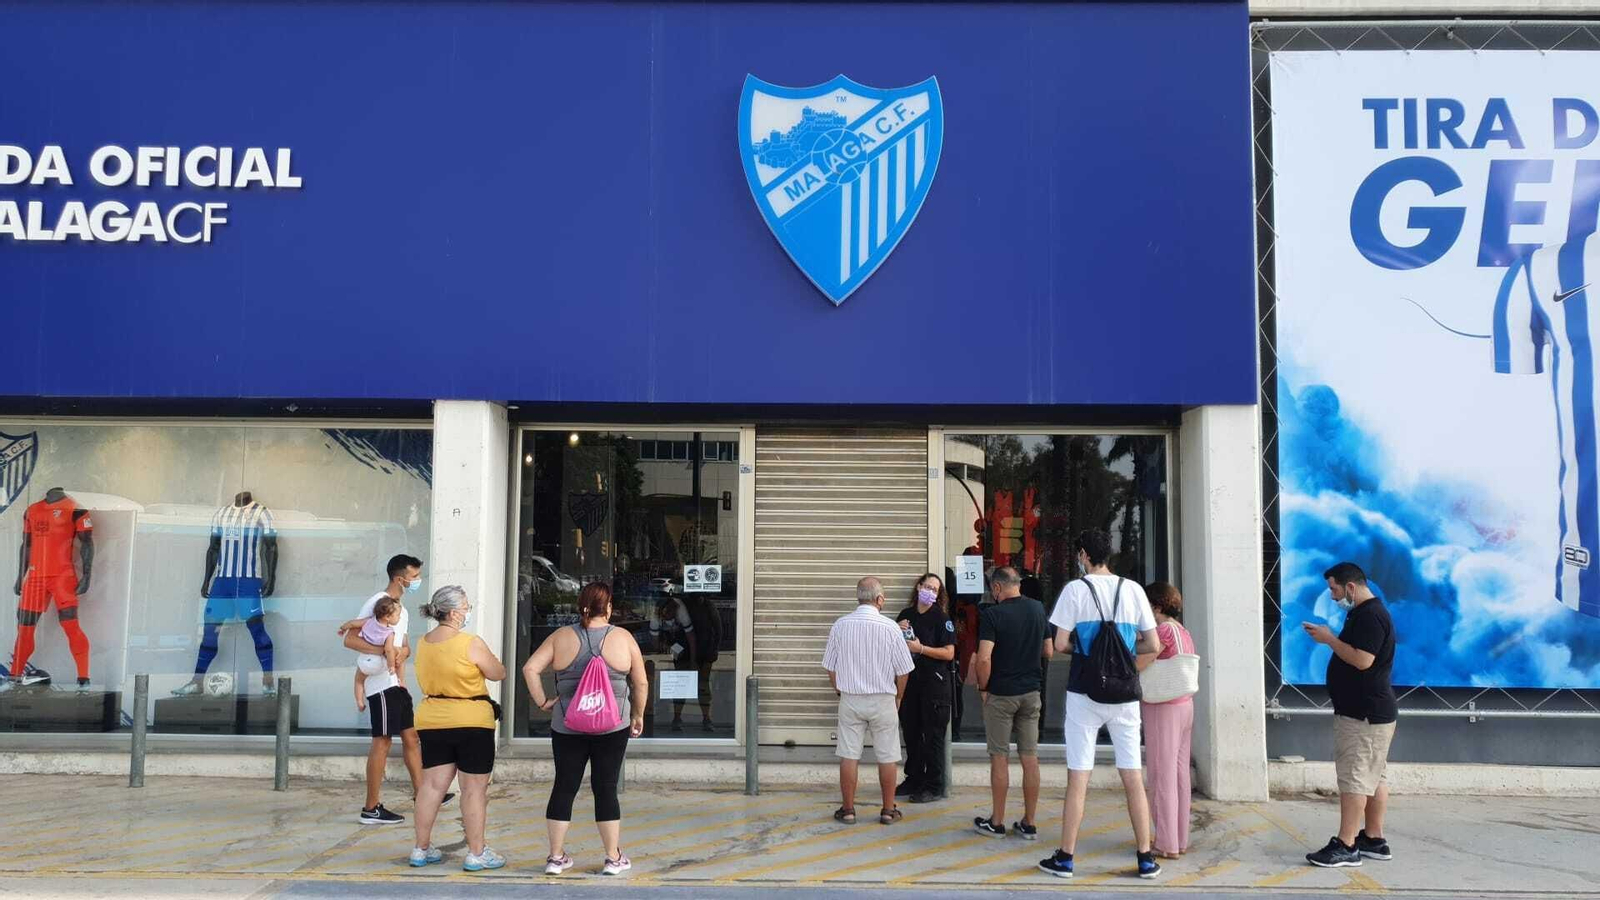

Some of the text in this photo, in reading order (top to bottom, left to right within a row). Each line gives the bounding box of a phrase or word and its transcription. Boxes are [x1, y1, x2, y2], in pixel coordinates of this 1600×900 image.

[874, 101, 916, 135] C.F.
[1362, 98, 1526, 150] TIRA
[90, 145, 303, 188] OFICIAL
[965, 571, 976, 580] 15
